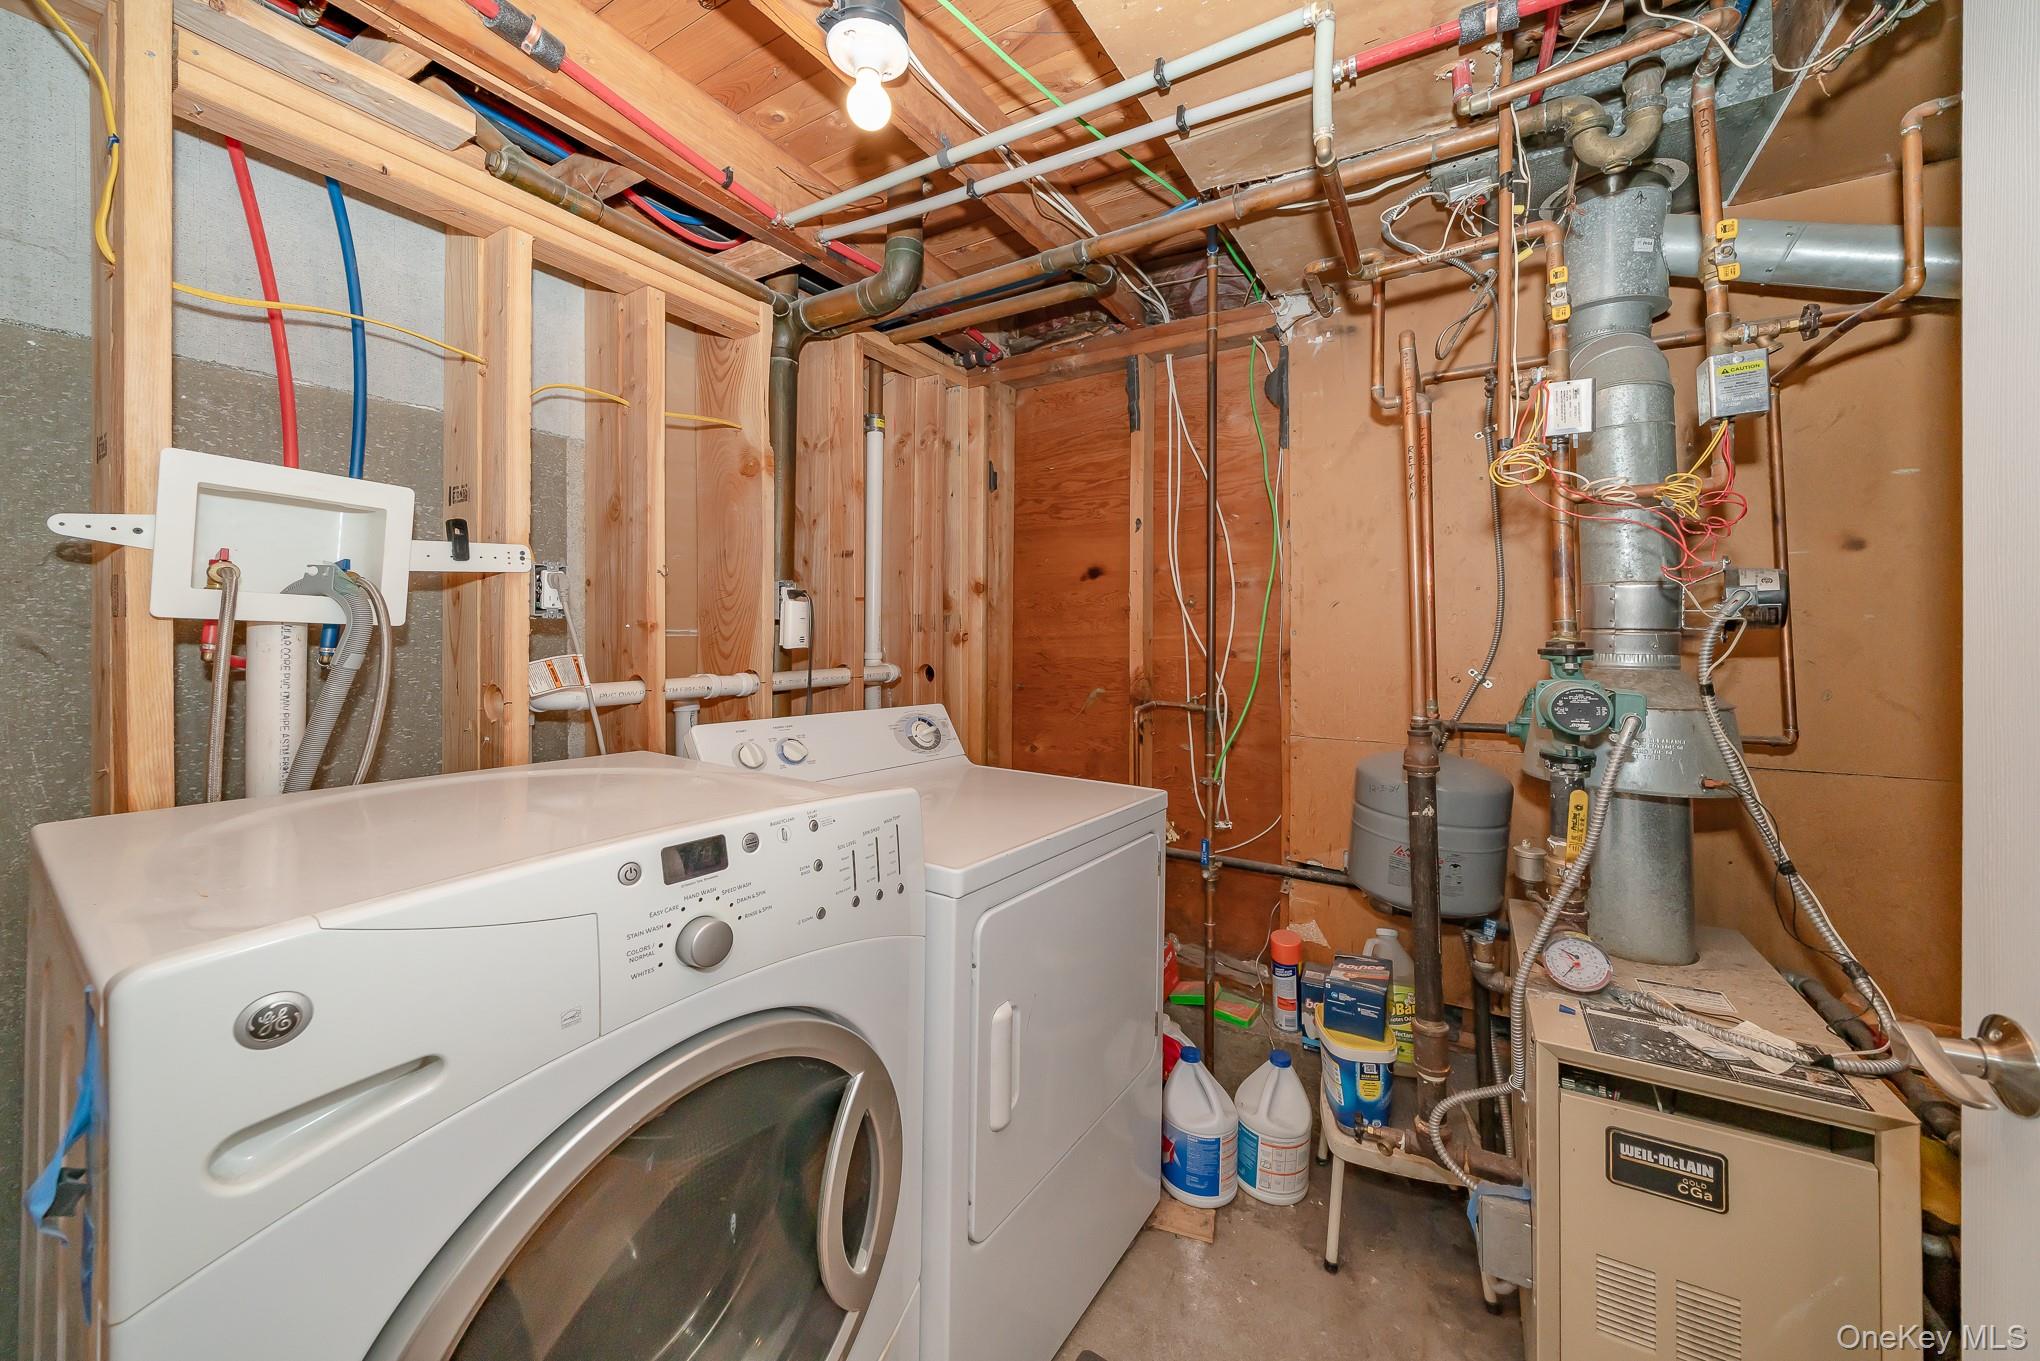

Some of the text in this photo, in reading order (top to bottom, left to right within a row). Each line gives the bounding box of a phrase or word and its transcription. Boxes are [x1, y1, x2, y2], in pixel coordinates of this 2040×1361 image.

[1699, 107, 1711, 138] TOP
[1730, 363, 1760, 373] CAUTION
[284, 647, 292, 671] CORE
[282, 712, 291, 731] PIPE
[683, 887, 717, 901] HAND WASH
[721, 882, 752, 895] SPEED WASH
[736, 895, 752, 904] DRAIN
[649, 904, 680, 919] EASY CARE
[744, 910, 758, 919] RINSE
[626, 924, 664, 941] STAIN WASH
[626, 945, 651, 957] COLORS
[628, 951, 655, 963] NORMAL
[1336, 962, 1386, 971] bounce
[630, 967, 655, 980] WHITES
[1682, 1178, 1707, 1190] GOLD
[1677, 1183, 1713, 1202] CGa
